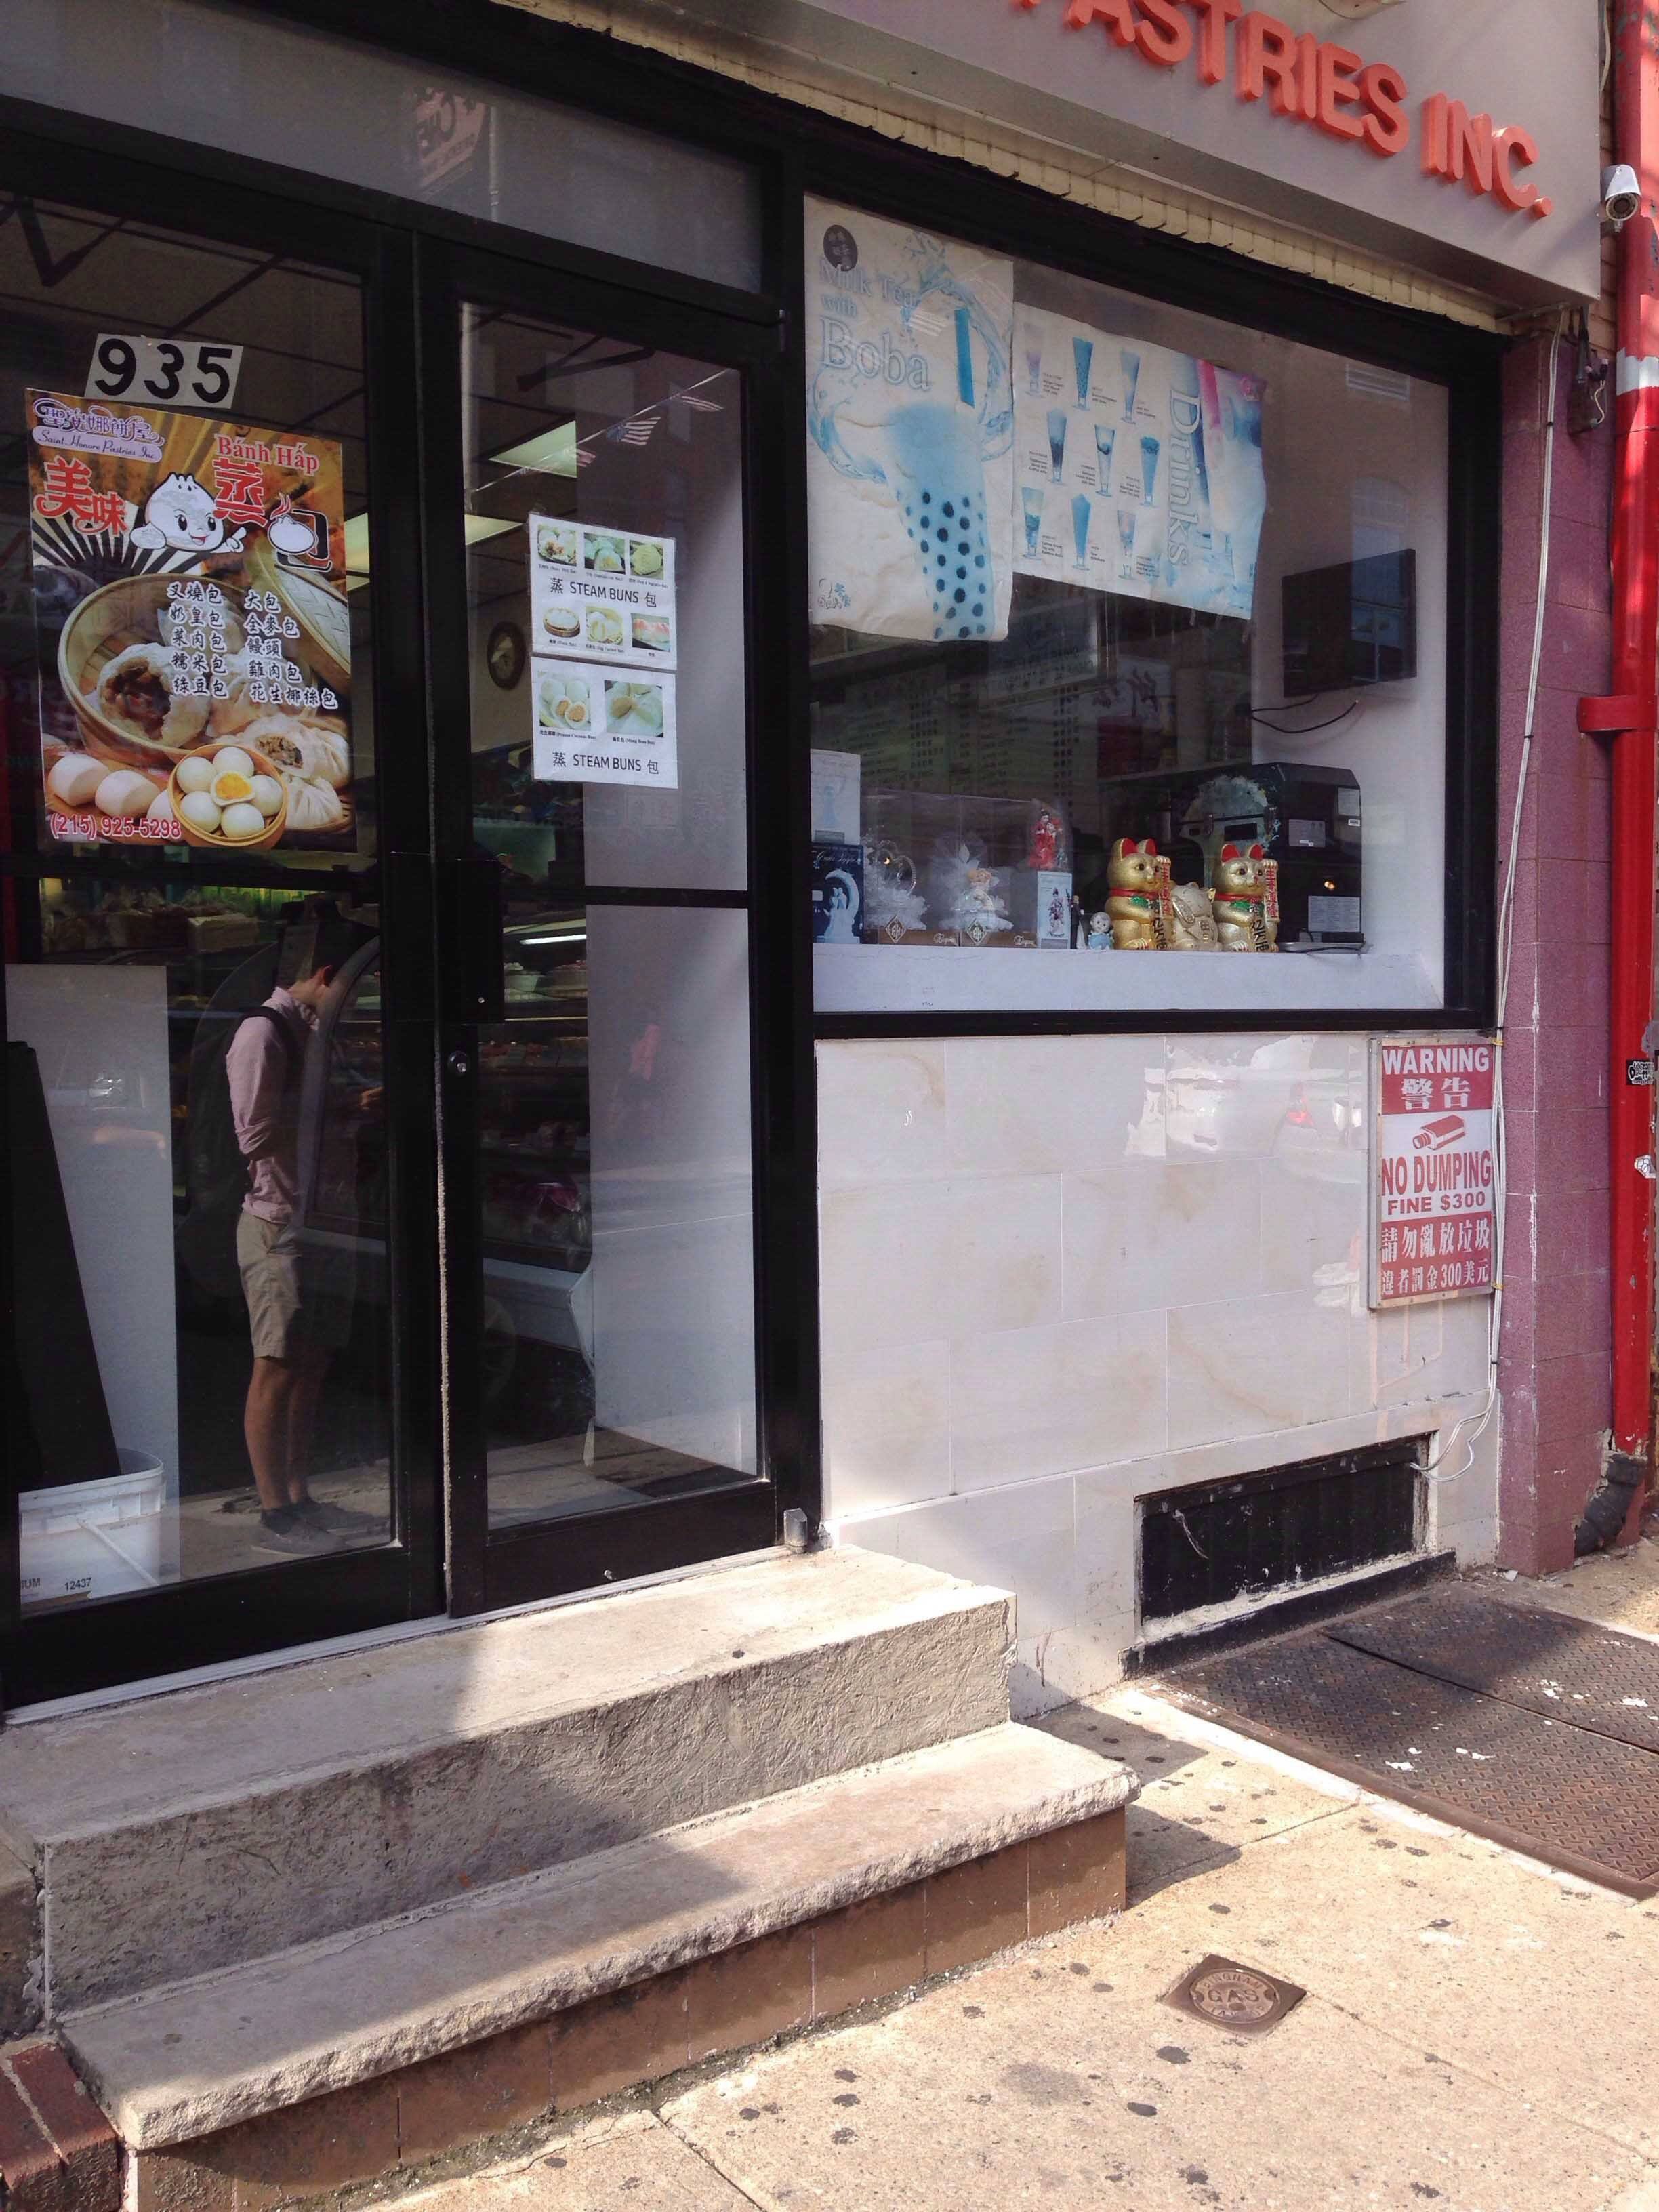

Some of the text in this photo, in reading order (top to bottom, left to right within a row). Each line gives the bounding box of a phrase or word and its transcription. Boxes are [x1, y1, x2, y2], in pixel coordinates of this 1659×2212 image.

[1017, 0, 1551, 217] STRIES INC.
[819, 256, 913, 306] Milk Tea
[821, 294, 857, 317] with
[819, 315, 931, 392] Boba
[94, 339, 233, 403] 935
[38, 429, 155, 459] Saint Honore Pastries Inc
[216, 435, 319, 476] Bánh Hấp
[1168, 390, 1200, 565] Drinks
[34, 455, 129, 535] 美味
[167, 582, 222, 605] 叉燒包
[245, 590, 281, 611] 大包
[570, 581, 607, 599] STEAM
[609, 586, 639, 604] BUNS
[644, 592, 657, 608] 包
[169, 603, 225, 628] 奶皇包
[244, 614, 300, 638] 全麥包
[172, 626, 226, 651] 菜肉包
[247, 636, 282, 657] 饅頭
[171, 651, 227, 675] 糯米包
[248, 659, 302, 683] 雞肉包
[173, 675, 228, 699] 綠豆包
[251, 682, 338, 709] 花生椰絲包
[573, 754, 610, 769] STEAM
[612, 757, 642, 771] BUNS
[647, 760, 659, 775] 包
[51, 813, 182, 840] (215) 925-5298
[1382, 1046, 1490, 1076] WARNING
[1401, 1077, 1471, 1111] 警告
[1381, 1150, 1491, 1196] NO DUMPING
[1387, 1191, 1486, 1216] FINE $300
[1381, 1218, 1490, 1263] 請勿亂放垃圾
[65, 1577, 92, 1591] 12437
[1208, 1989, 1260, 2003] GAS
